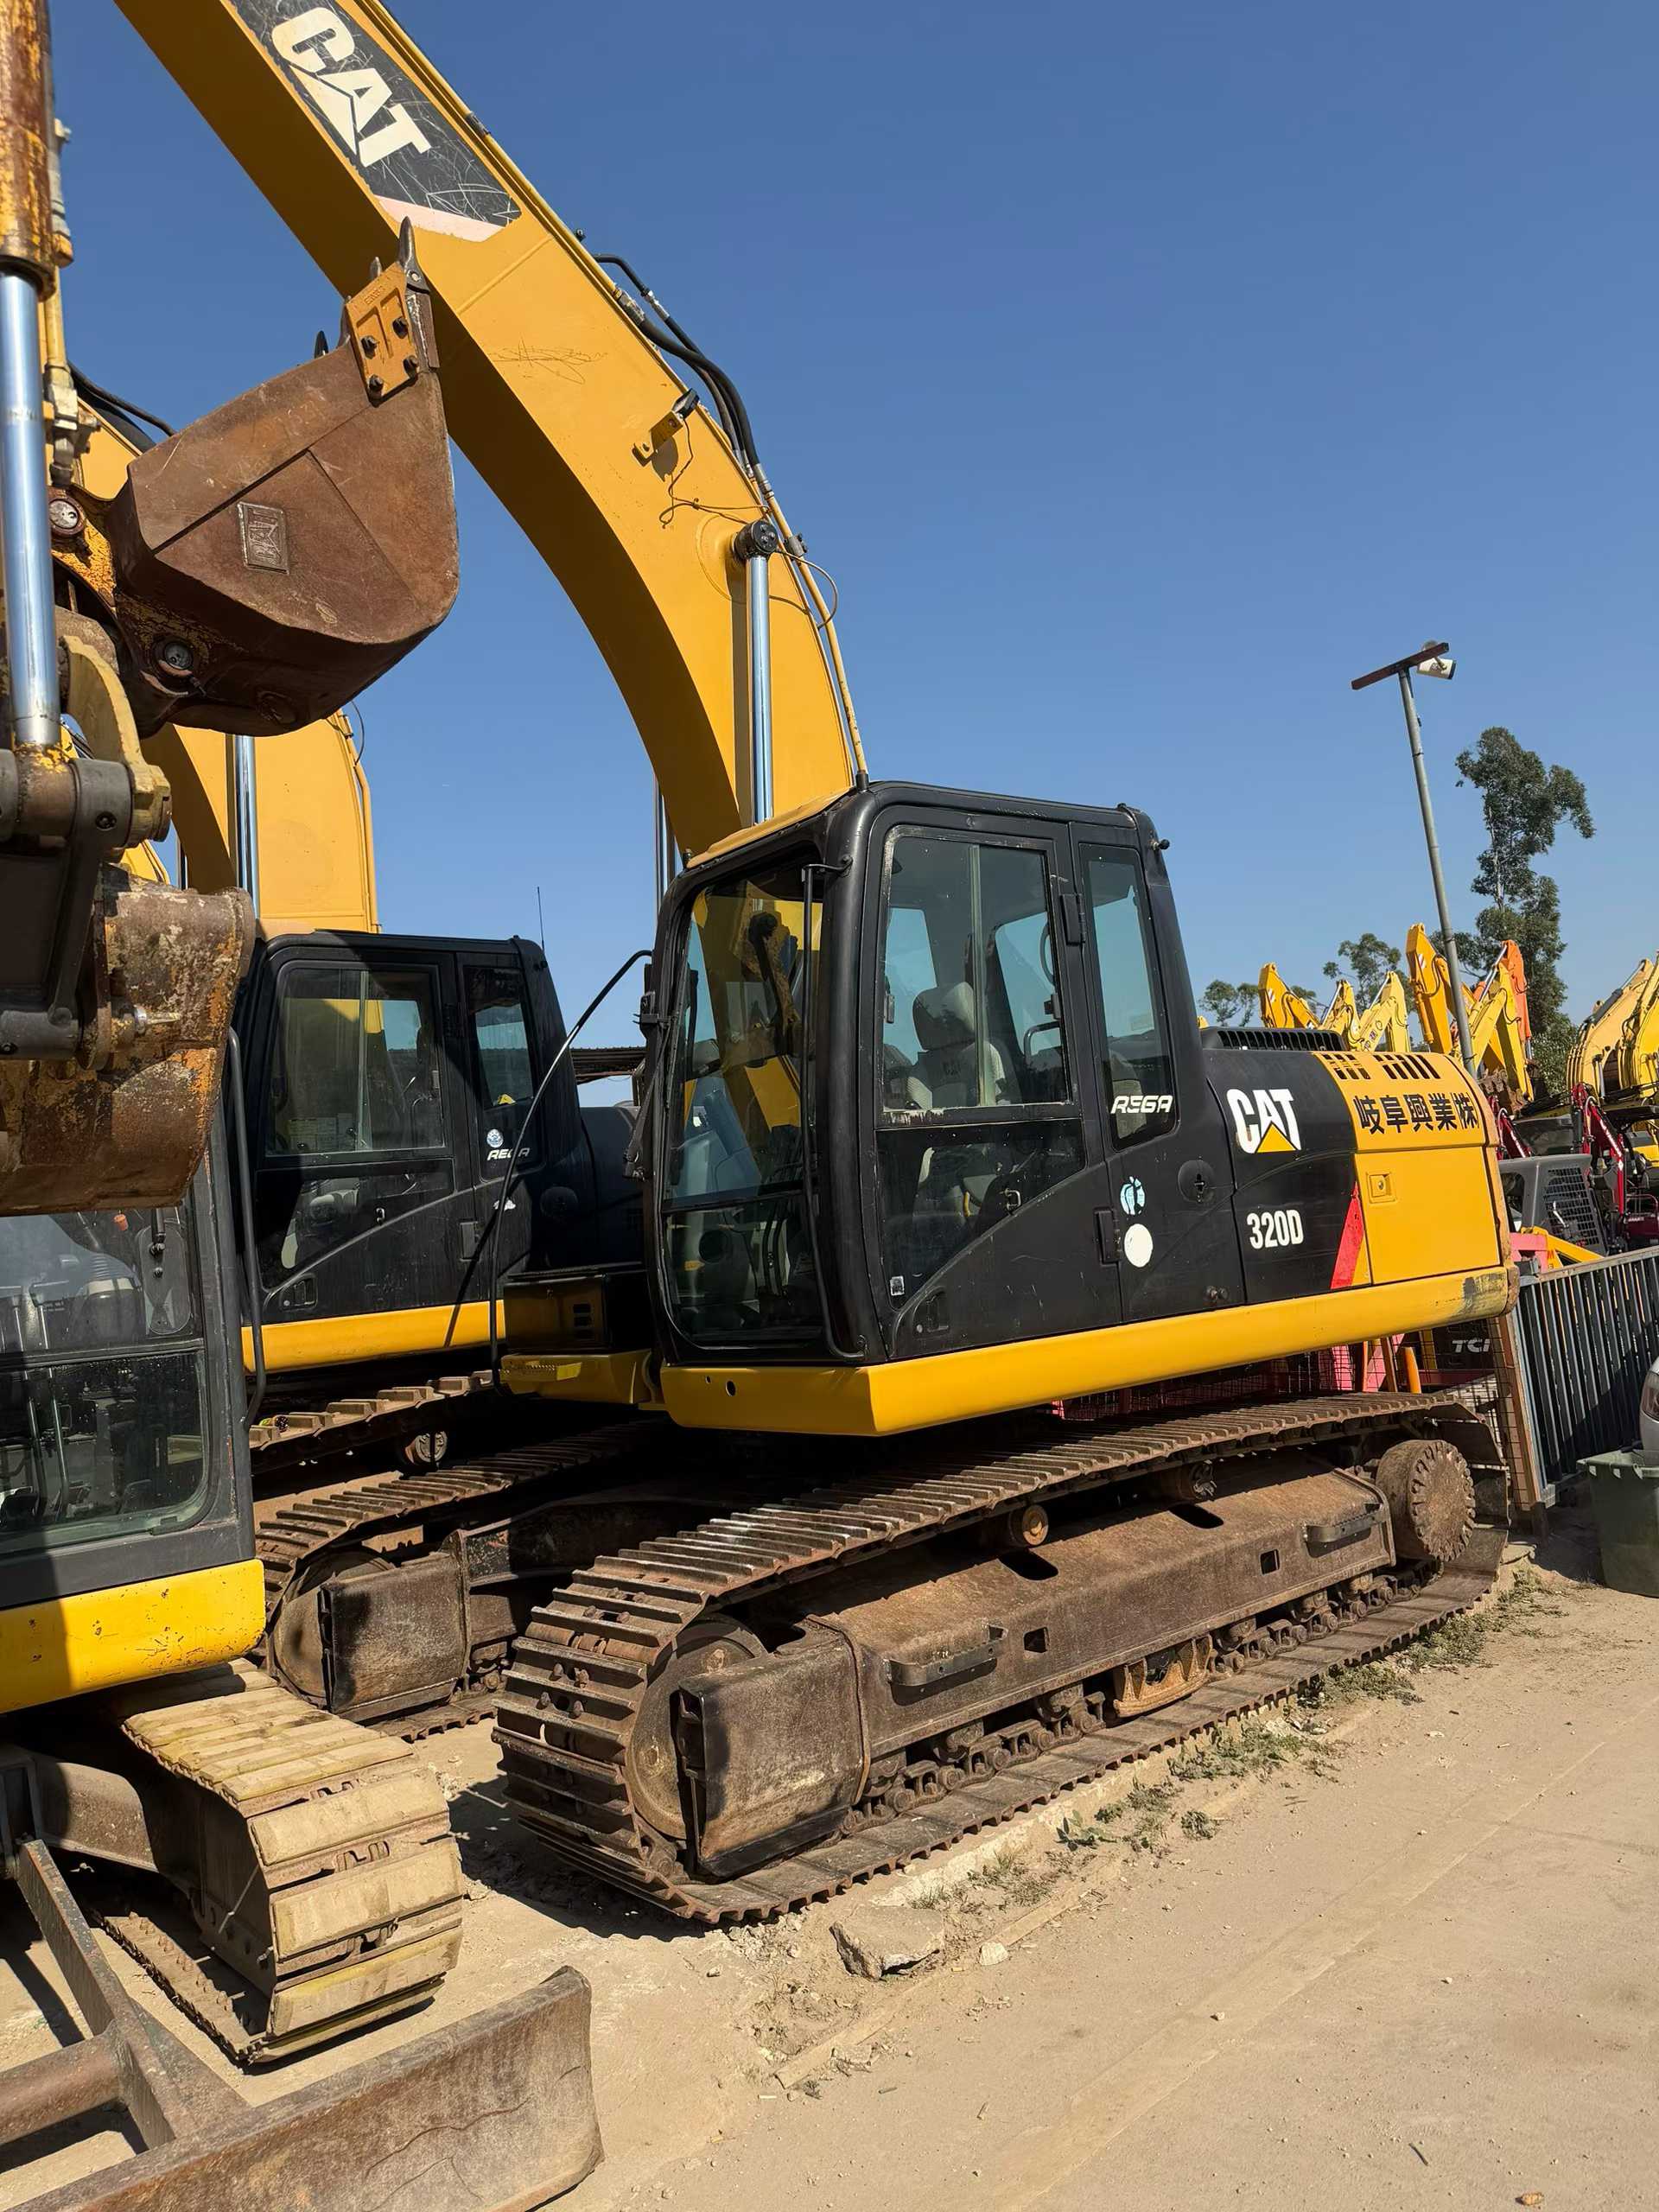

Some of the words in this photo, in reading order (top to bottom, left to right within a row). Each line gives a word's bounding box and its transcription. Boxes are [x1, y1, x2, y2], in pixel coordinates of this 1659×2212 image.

[271, 7, 431, 167] CAT
[1226, 1089, 1301, 1154] CAT
[1246, 1210, 1305, 1249] 320D
